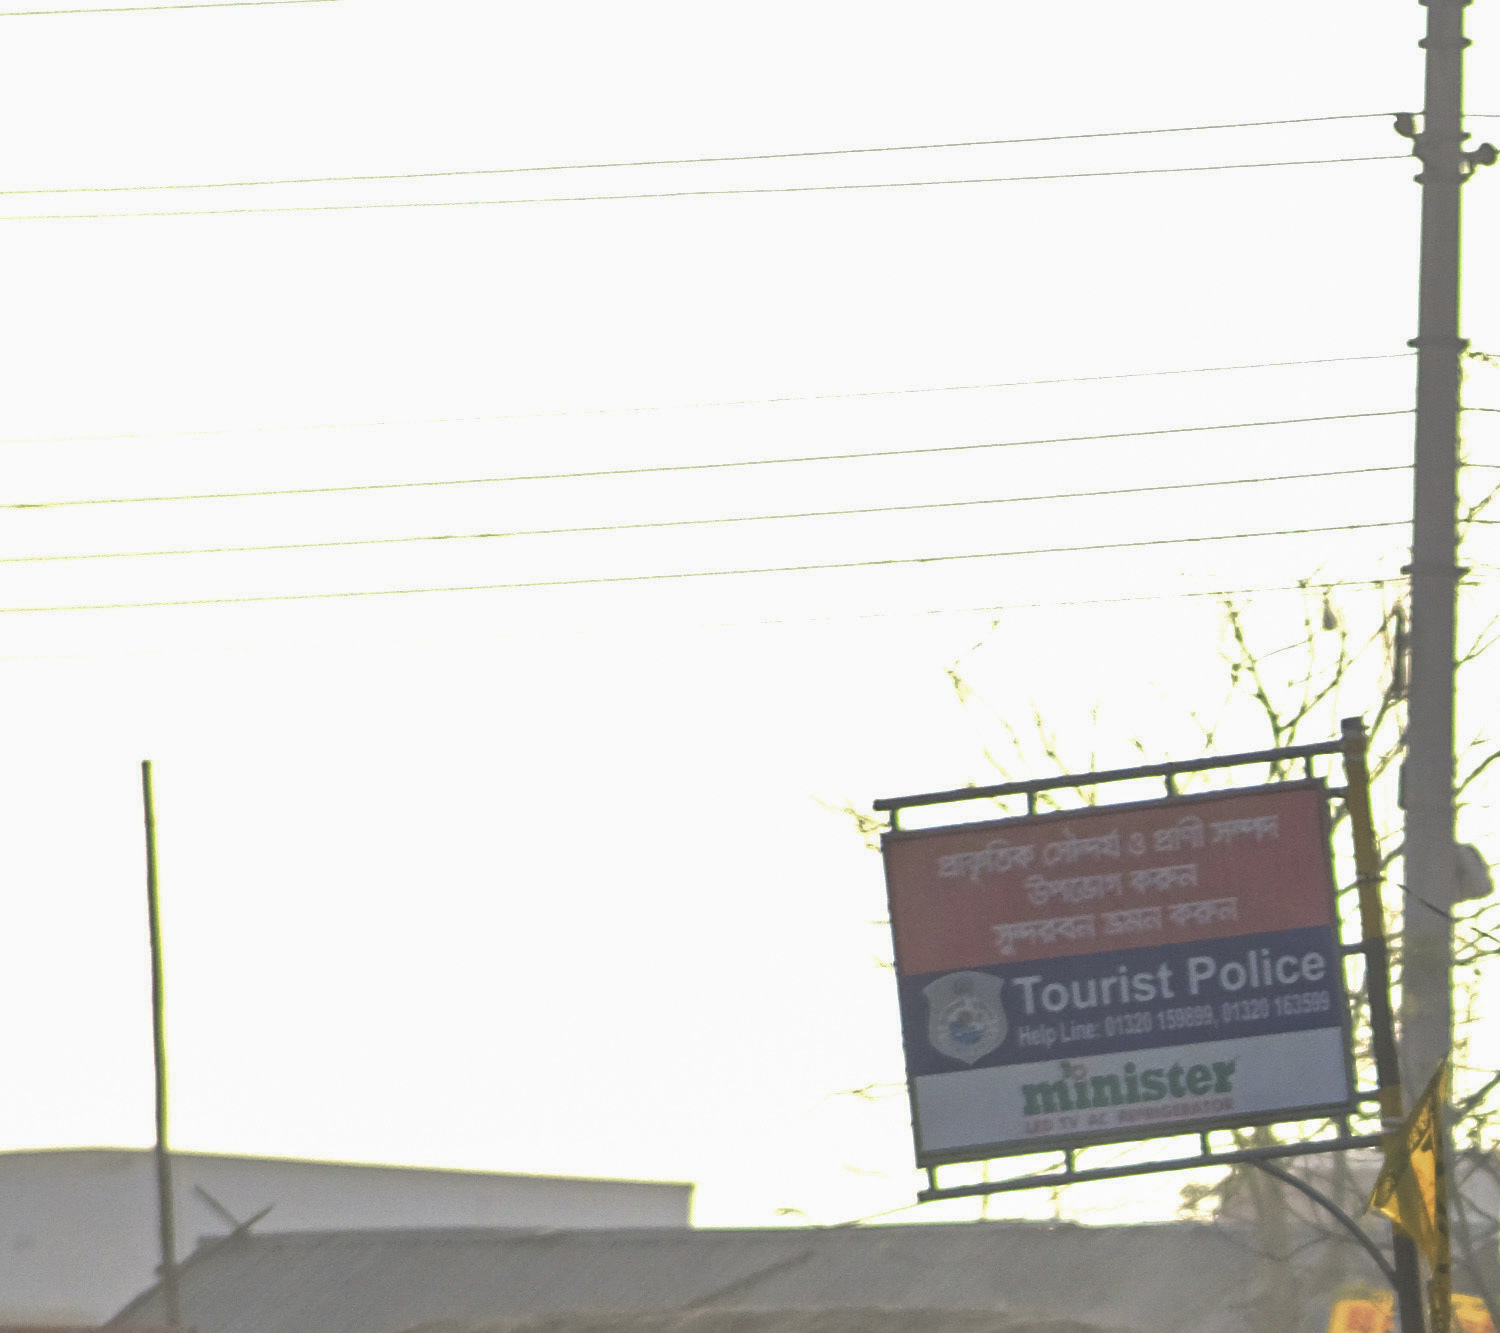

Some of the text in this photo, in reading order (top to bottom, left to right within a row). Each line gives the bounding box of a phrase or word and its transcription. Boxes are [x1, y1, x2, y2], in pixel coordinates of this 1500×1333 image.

[1128, 833, 1147, 856] ও
[1024, 863, 1199, 906] উপভোগ করুন
[993, 913, 1097, 957] সুন্দরবন
[1168, 896, 1239, 926] করুন
[1013, 948, 1327, 1015] Tourist Police
[1017, 1022, 1058, 1049] Help
[1060, 1018, 1100, 1042] Line:
[1222, 998, 1270, 1023] 01320
[1021, 1060, 1238, 1116] minister
